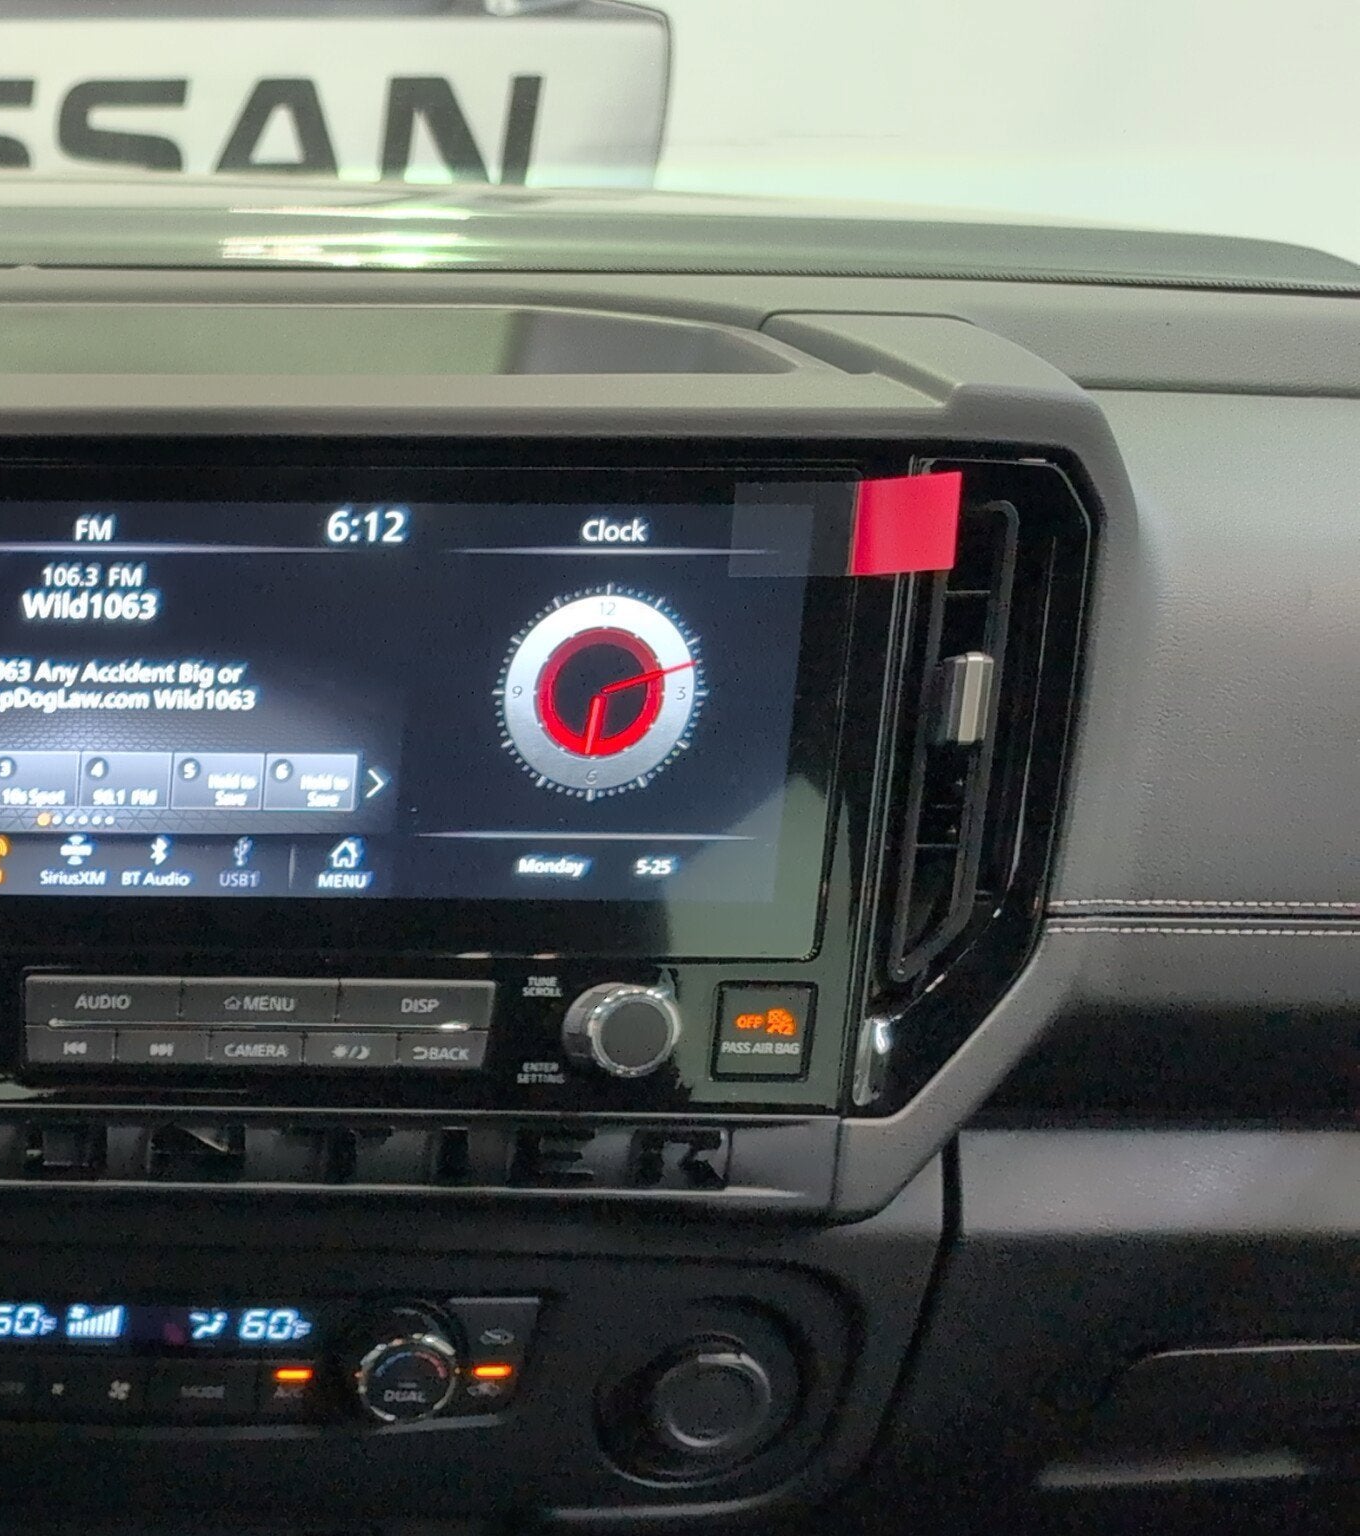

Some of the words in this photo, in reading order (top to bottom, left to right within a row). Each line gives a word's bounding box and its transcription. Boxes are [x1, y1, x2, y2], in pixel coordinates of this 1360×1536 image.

[75, 517, 114, 541] FM
[326, 510, 407, 544] 6:12
[582, 519, 647, 544] Clock
[42, 565, 100, 587] 106.3
[108, 565, 145, 587] FM
[21, 590, 159, 621] Wild1063
[34, 661, 79, 687] Any
[80, 662, 176, 684] Accident
[178, 663, 214, 689] Big
[217, 665, 246, 684] or
[153, 689, 257, 711] Wild1063
[512, 686, 523, 699] 9
[675, 687, 687, 701] 3
[90, 760, 105, 778] 4
[517, 857, 587, 878] Monday
[635, 858, 675, 876] 5-25
[39, 869, 107, 886] SiriusXM
[121, 871, 140, 886] BT
[142, 871, 192, 888] Audio
[218, 871, 260, 888] USB1
[317, 872, 371, 889] MENU
[75, 994, 131, 1011] AUDIO
[243, 996, 295, 1013] MENU
[401, 997, 440, 1014] DISP
[736, 1013, 764, 1029] OFF
[224, 1043, 288, 1059] CAMERA
[428, 1046, 470, 1062] BACK
[721, 1041, 751, 1054] PASS
[752, 1042, 774, 1055] AIR
[384, 1389, 427, 1403] DUAL
